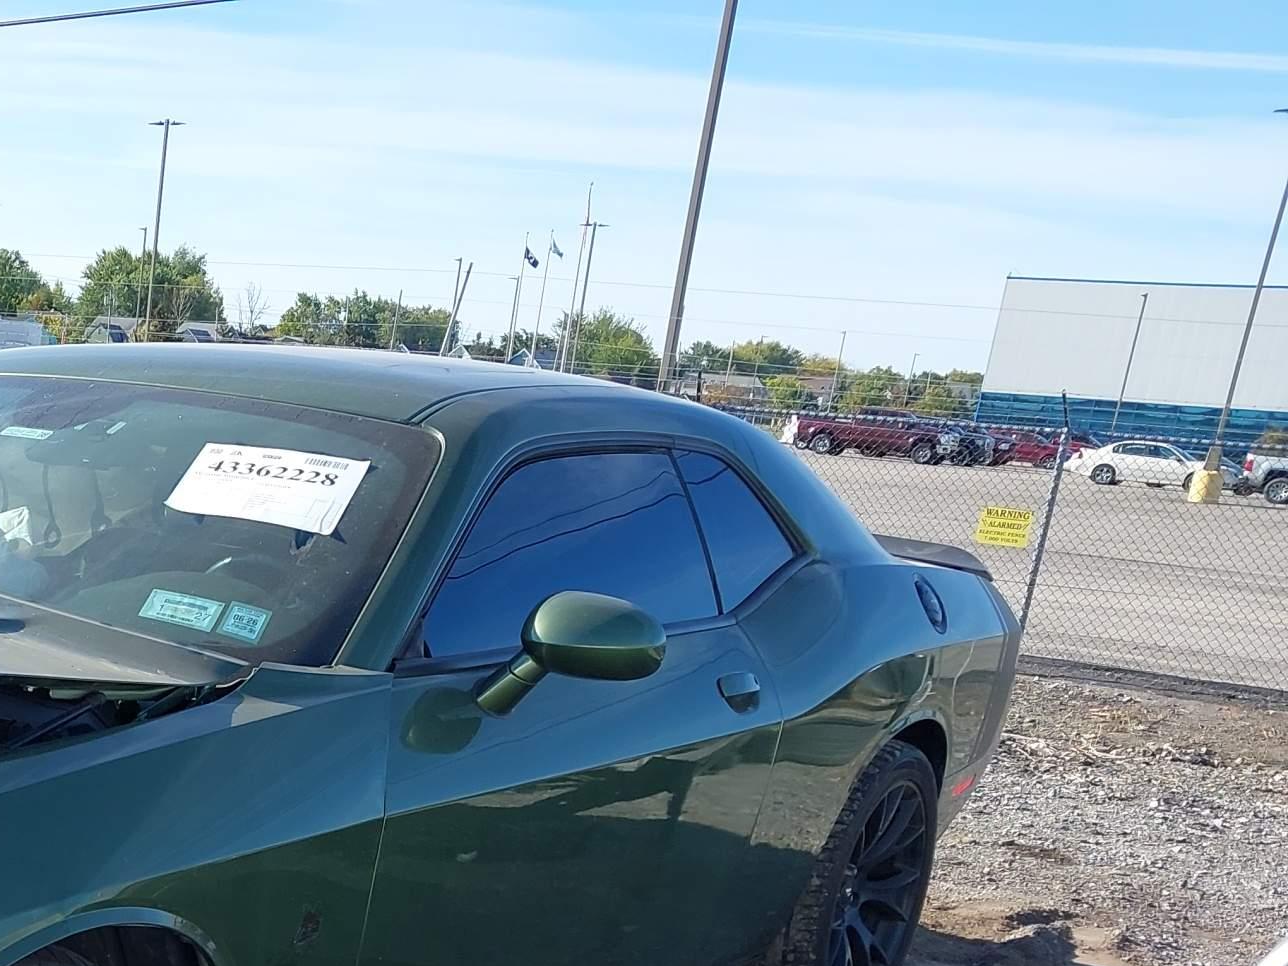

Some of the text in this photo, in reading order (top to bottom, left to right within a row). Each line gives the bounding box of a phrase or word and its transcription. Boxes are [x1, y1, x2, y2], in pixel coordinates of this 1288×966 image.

[208, 460, 339, 487] 43362228
[986, 508, 1030, 520] WARNING
[989, 521, 1022, 530] ALARMED
